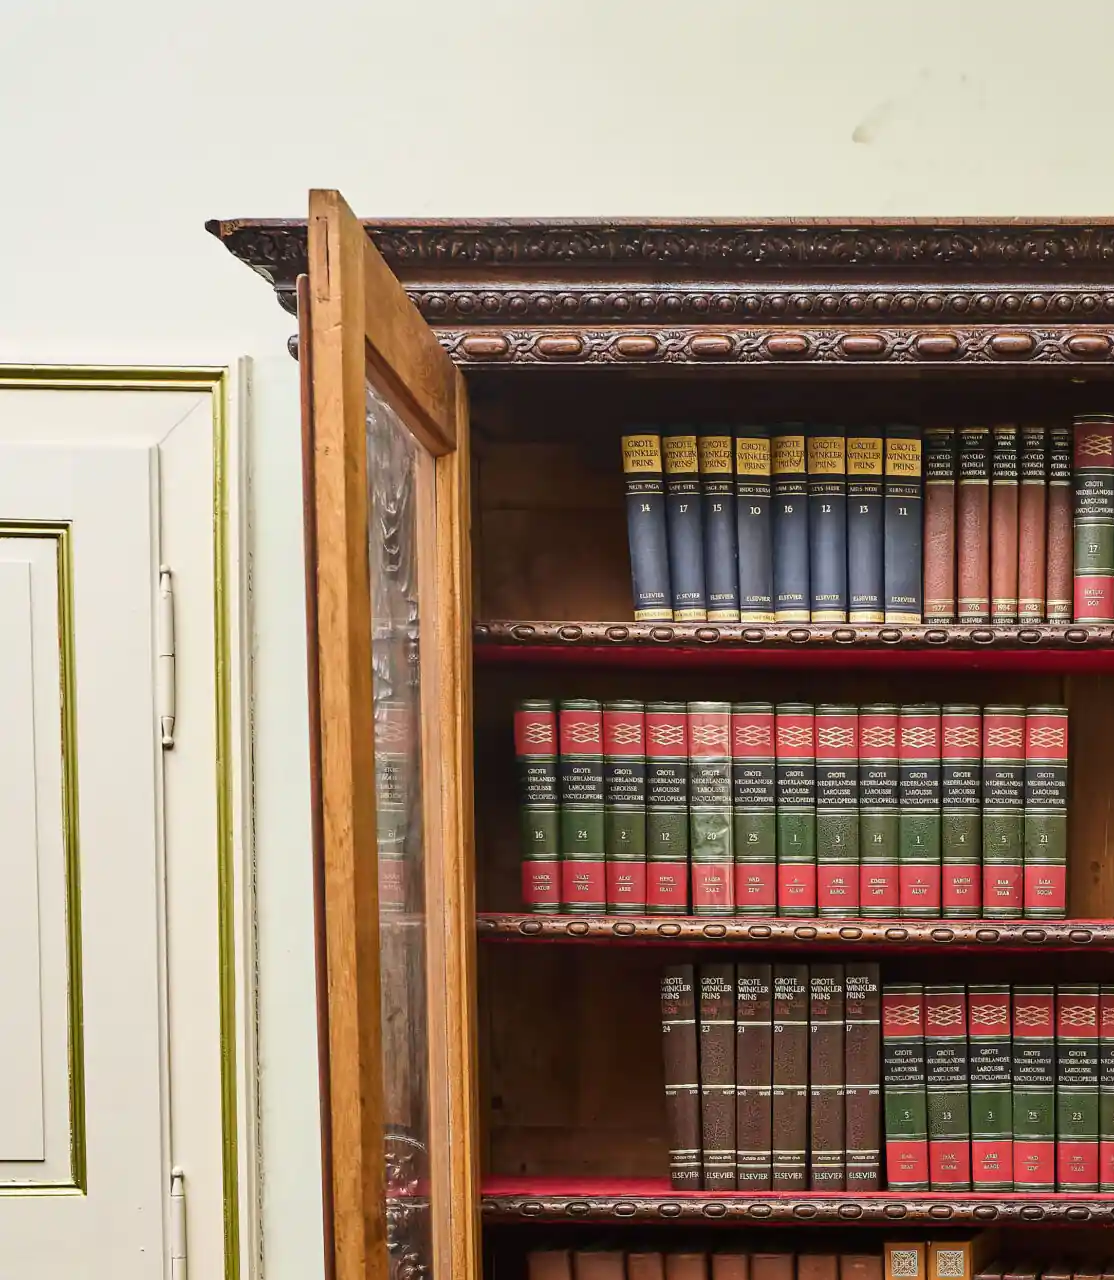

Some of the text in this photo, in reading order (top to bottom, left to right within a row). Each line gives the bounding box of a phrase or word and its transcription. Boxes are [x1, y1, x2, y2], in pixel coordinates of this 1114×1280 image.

[628, 440, 653, 448] GROTE
[625, 448, 659, 457] WINKLER
[739, 451, 771, 461] WINKLER
[810, 451, 842, 459] WINKLER
[848, 451, 880, 459] WINKLER
[887, 453, 920, 461] WINKLER
[706, 460, 726, 468] PRINS
[745, 462, 765, 470] PRINS
[641, 504, 651, 512] 14
[713, 504, 722, 512] 15
[749, 834, 758, 842] 25
[811, 978, 834, 986] GROTE
[846, 977, 869, 985] GROTE
[775, 985, 806, 993] WINKLER
[811, 985, 842, 993] WINKLER
[702, 992, 721, 1000] PRINS
